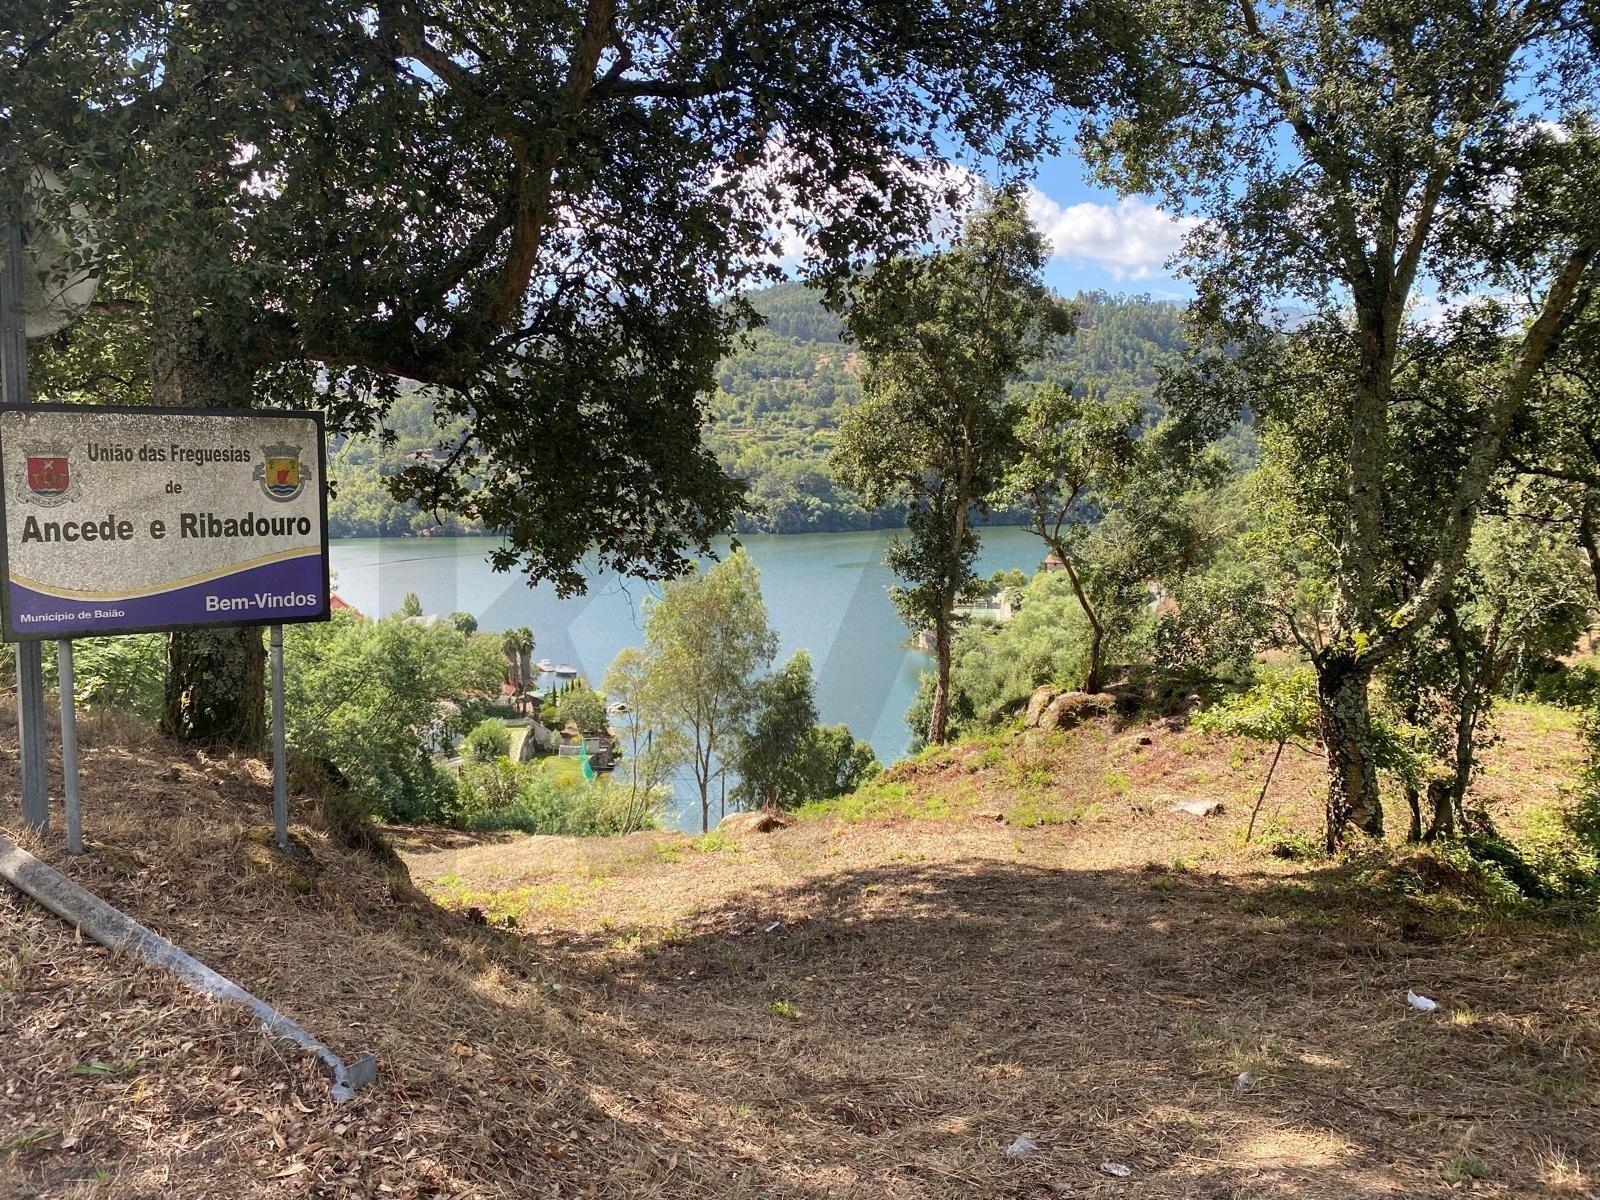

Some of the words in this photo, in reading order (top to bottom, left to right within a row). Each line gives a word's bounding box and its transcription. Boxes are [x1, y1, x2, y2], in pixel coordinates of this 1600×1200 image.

[87, 443, 134, 462] União
[138, 444, 166, 462] das
[171, 444, 251, 466] Freguesias
[165, 480, 182, 494] de
[21, 514, 134, 543] Ancede
[149, 519, 166, 540] e
[180, 511, 311, 539] Ribadouro
[205, 591, 317, 612] Bem-Vindos
[20, 611, 75, 623] Município
[77, 611, 92, 620] de
[94, 609, 125, 619] Baião
